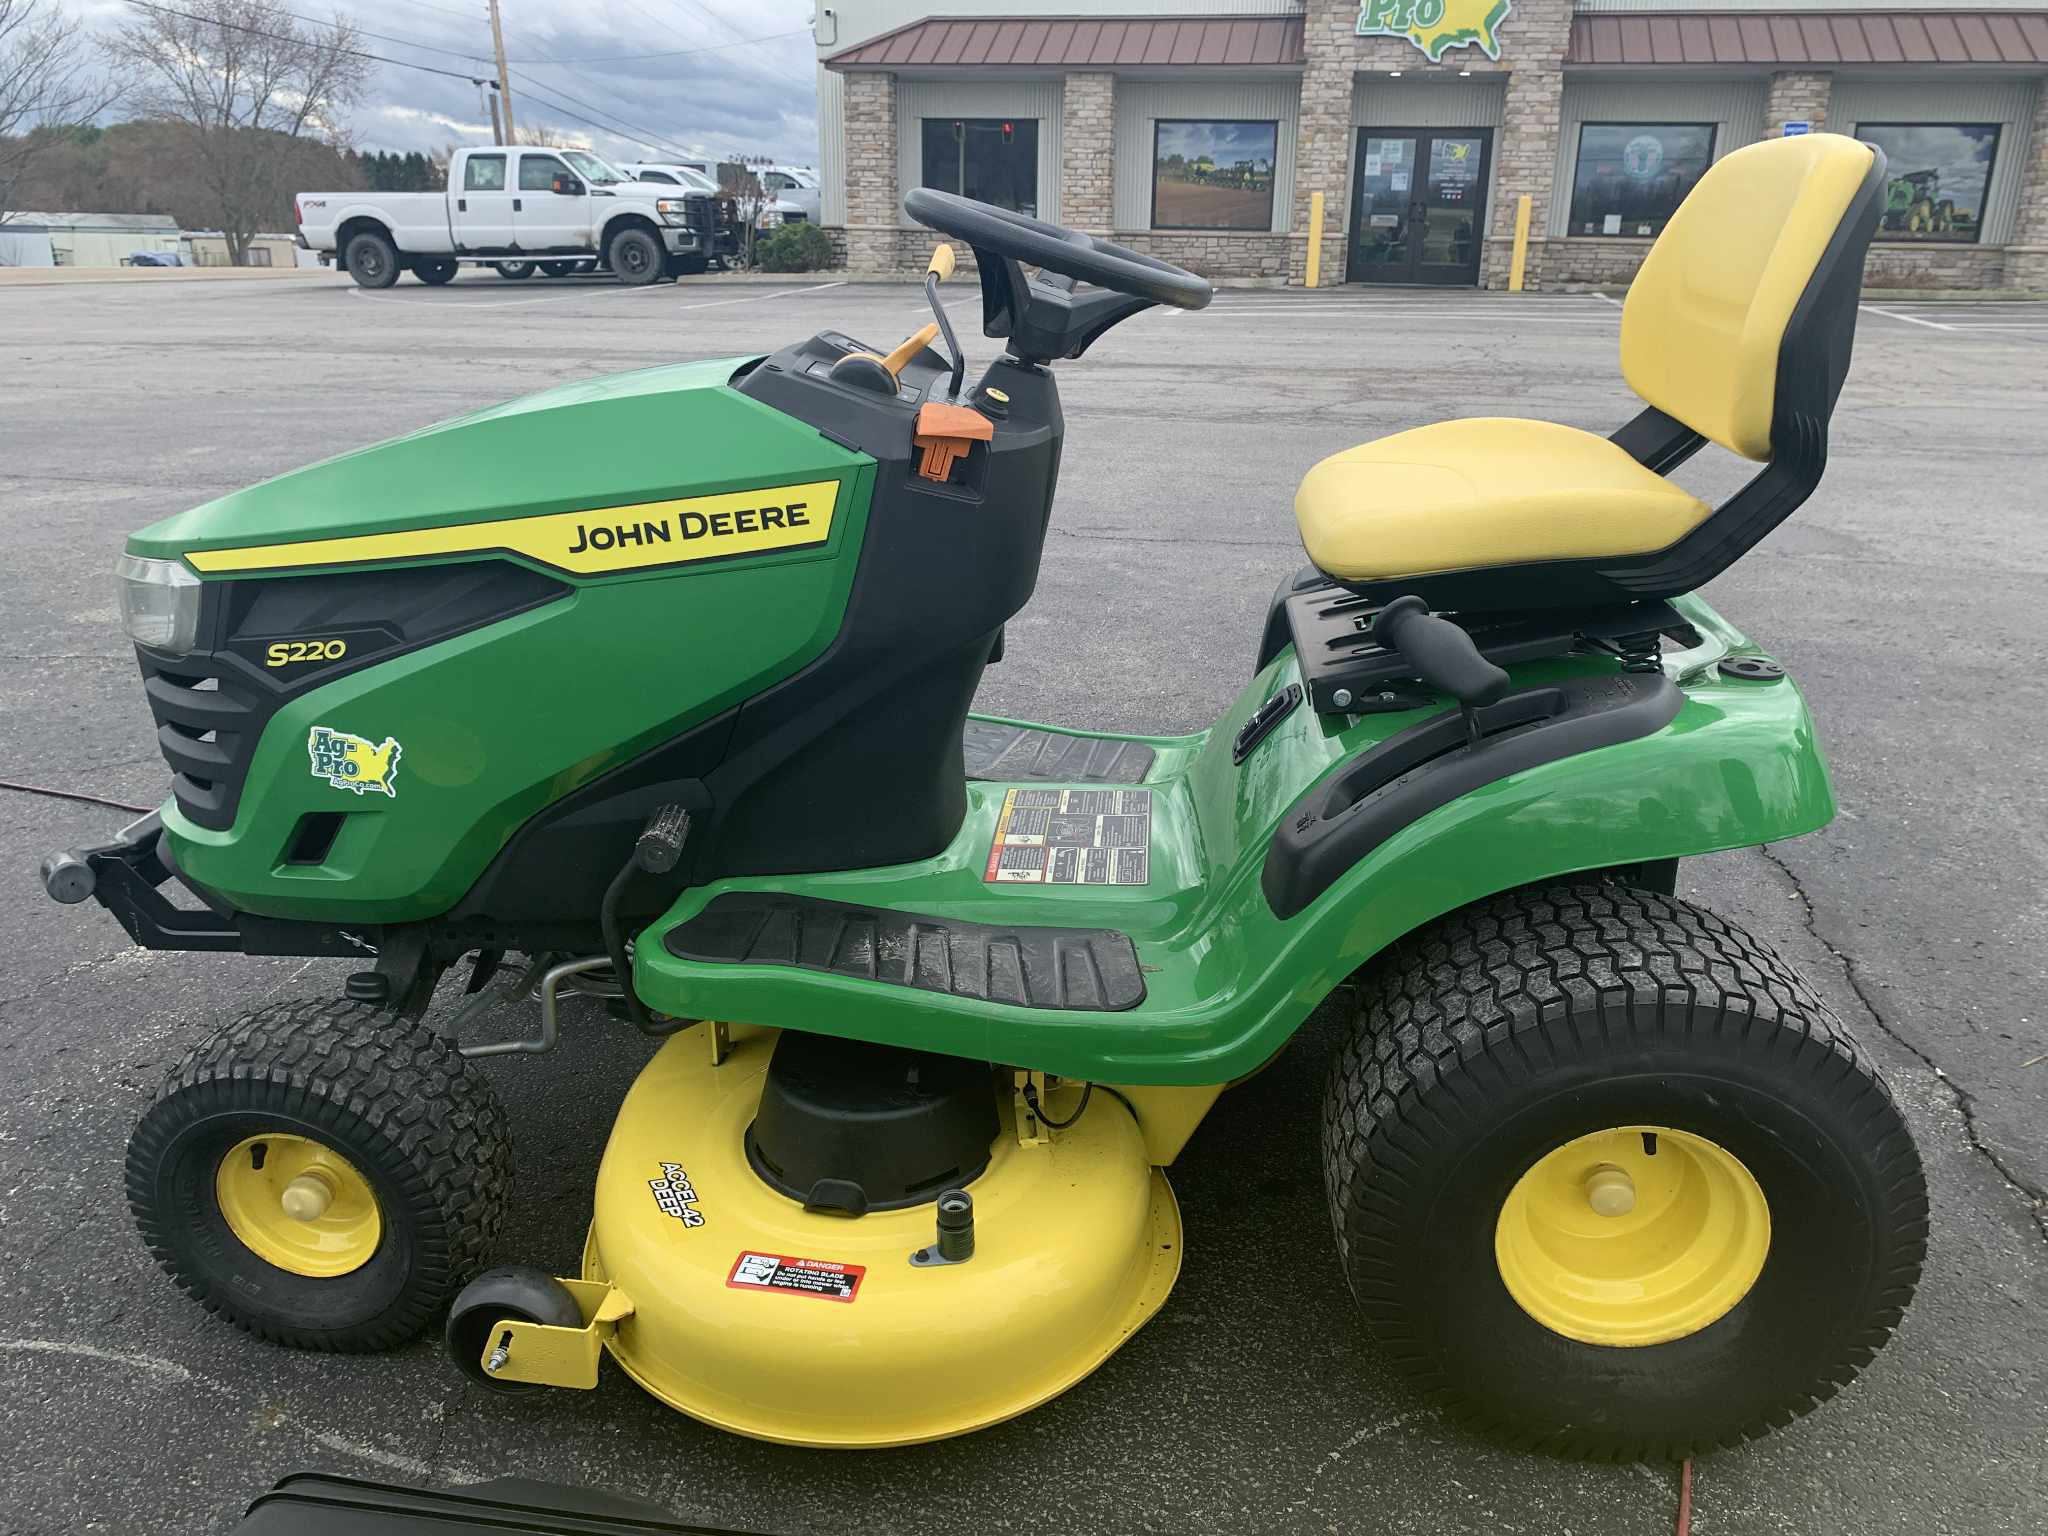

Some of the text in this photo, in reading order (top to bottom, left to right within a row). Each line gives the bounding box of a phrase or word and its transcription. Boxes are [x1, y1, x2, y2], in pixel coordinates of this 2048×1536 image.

[568, 502, 810, 554] JOHN DEERE
[266, 639, 347, 667] S220
[313, 731, 357, 760] Ag-
[315, 753, 359, 776] Pro
[647, 1178, 684, 1218] DEEP
[785, 1266, 845, 1279] ROTATING BLADE
[806, 1261, 844, 1270] DANGER
[800, 1283, 823, 1292] running
